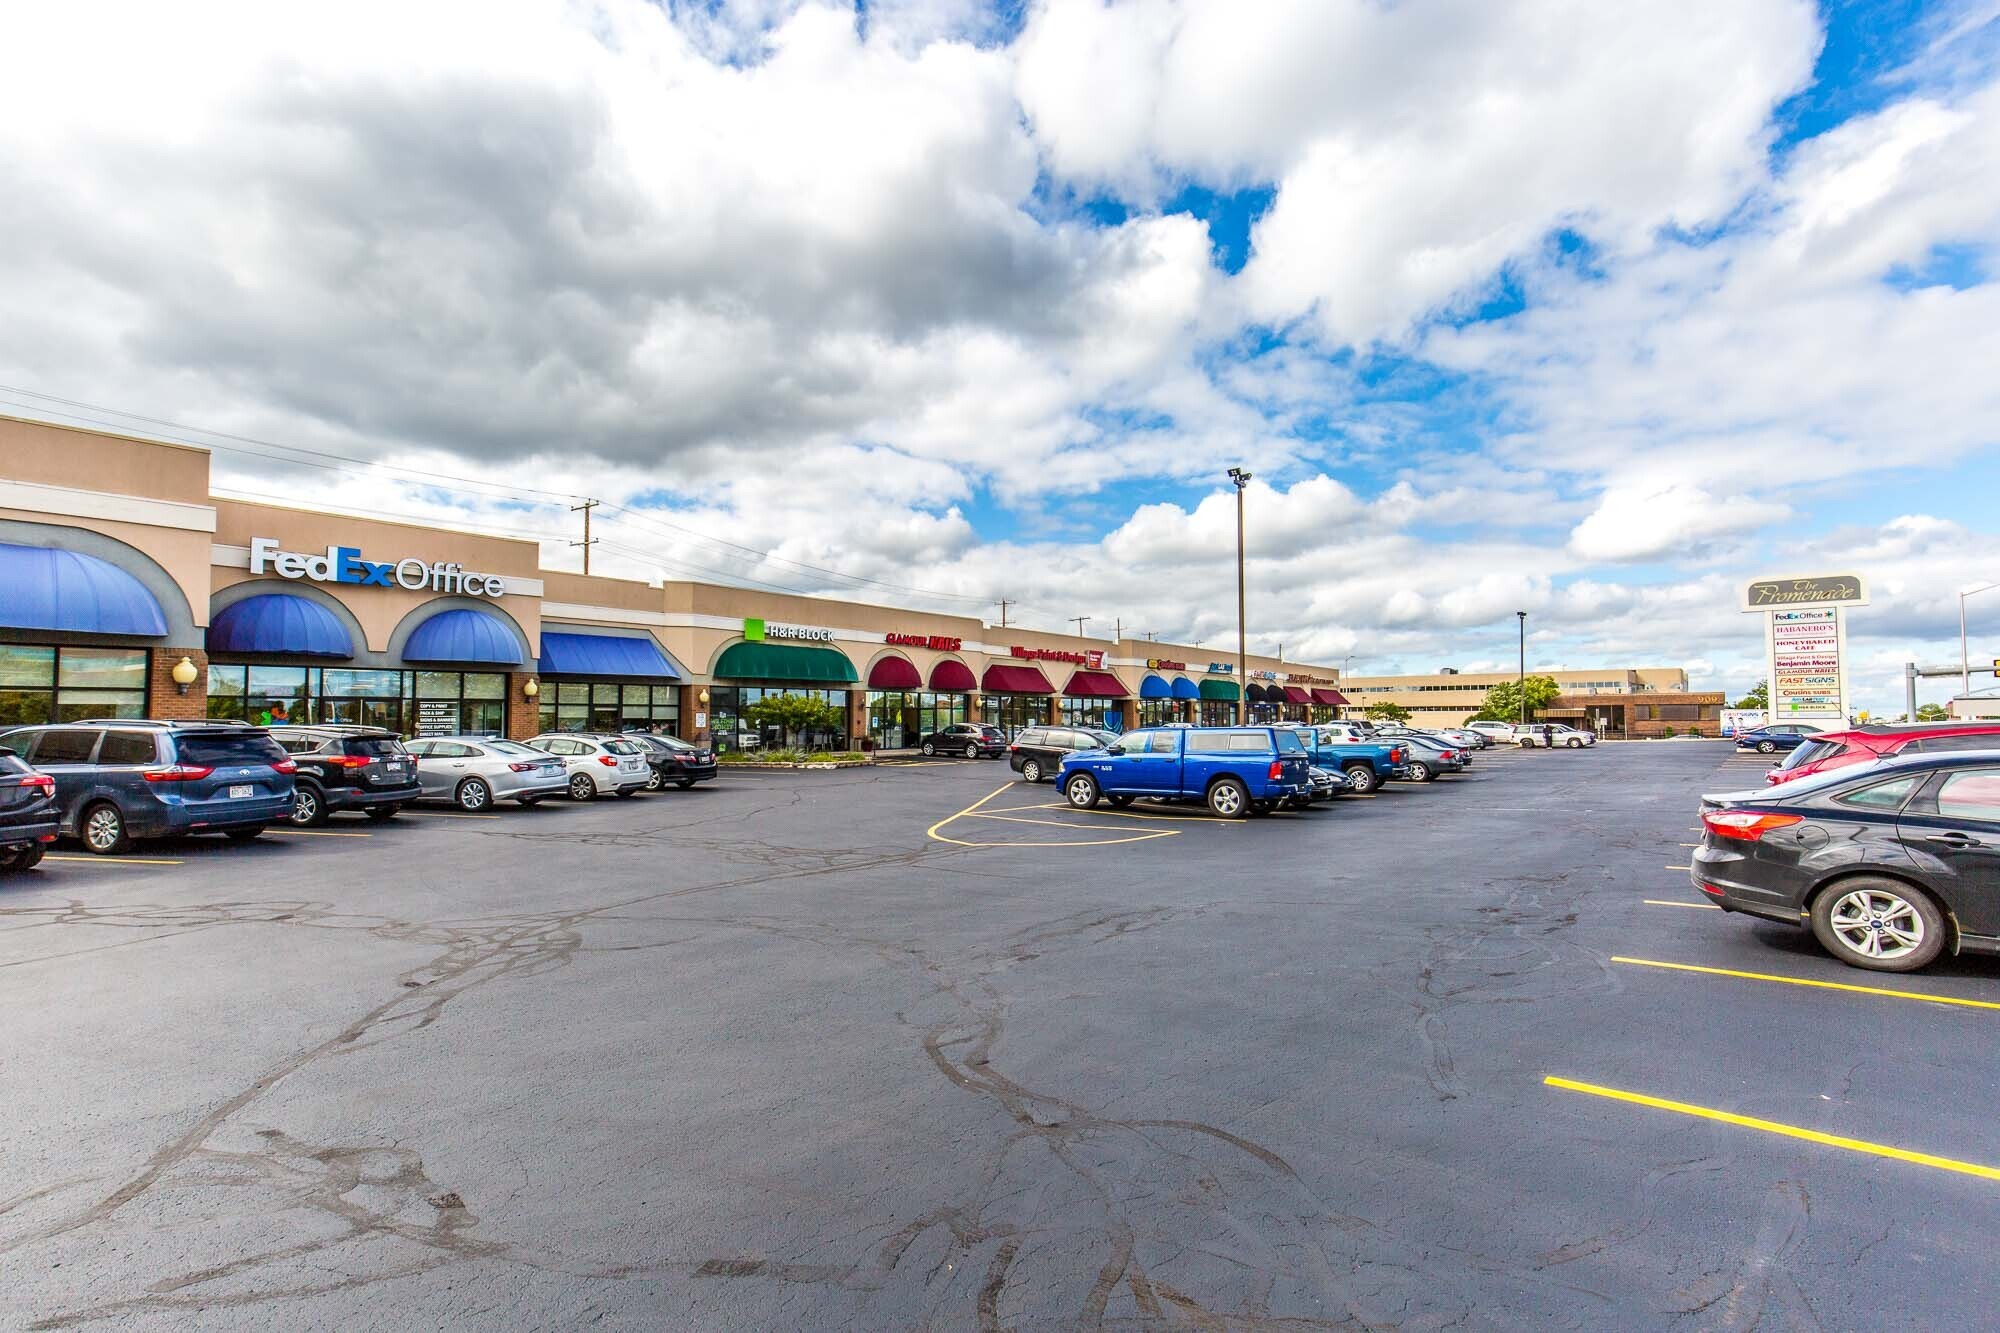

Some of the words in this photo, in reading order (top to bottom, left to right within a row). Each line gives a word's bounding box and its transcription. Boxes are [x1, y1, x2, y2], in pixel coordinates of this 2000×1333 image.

[250, 536, 394, 587] FedEx
[395, 558, 506, 598] Office
[1792, 580, 1818, 591] The
[1753, 583, 1855, 604] Promenade
[1775, 612, 1799, 620] FedEx
[769, 625, 796, 639] H&R
[798, 628, 834, 641] BLOCK
[1776, 625, 1834, 633] HABANERO'S
[886, 632, 927, 648] GLAMOUR
[928, 635, 962, 652] NAILS
[1011, 646, 1037, 661] Village
[1038, 649, 1056, 661] Paint
